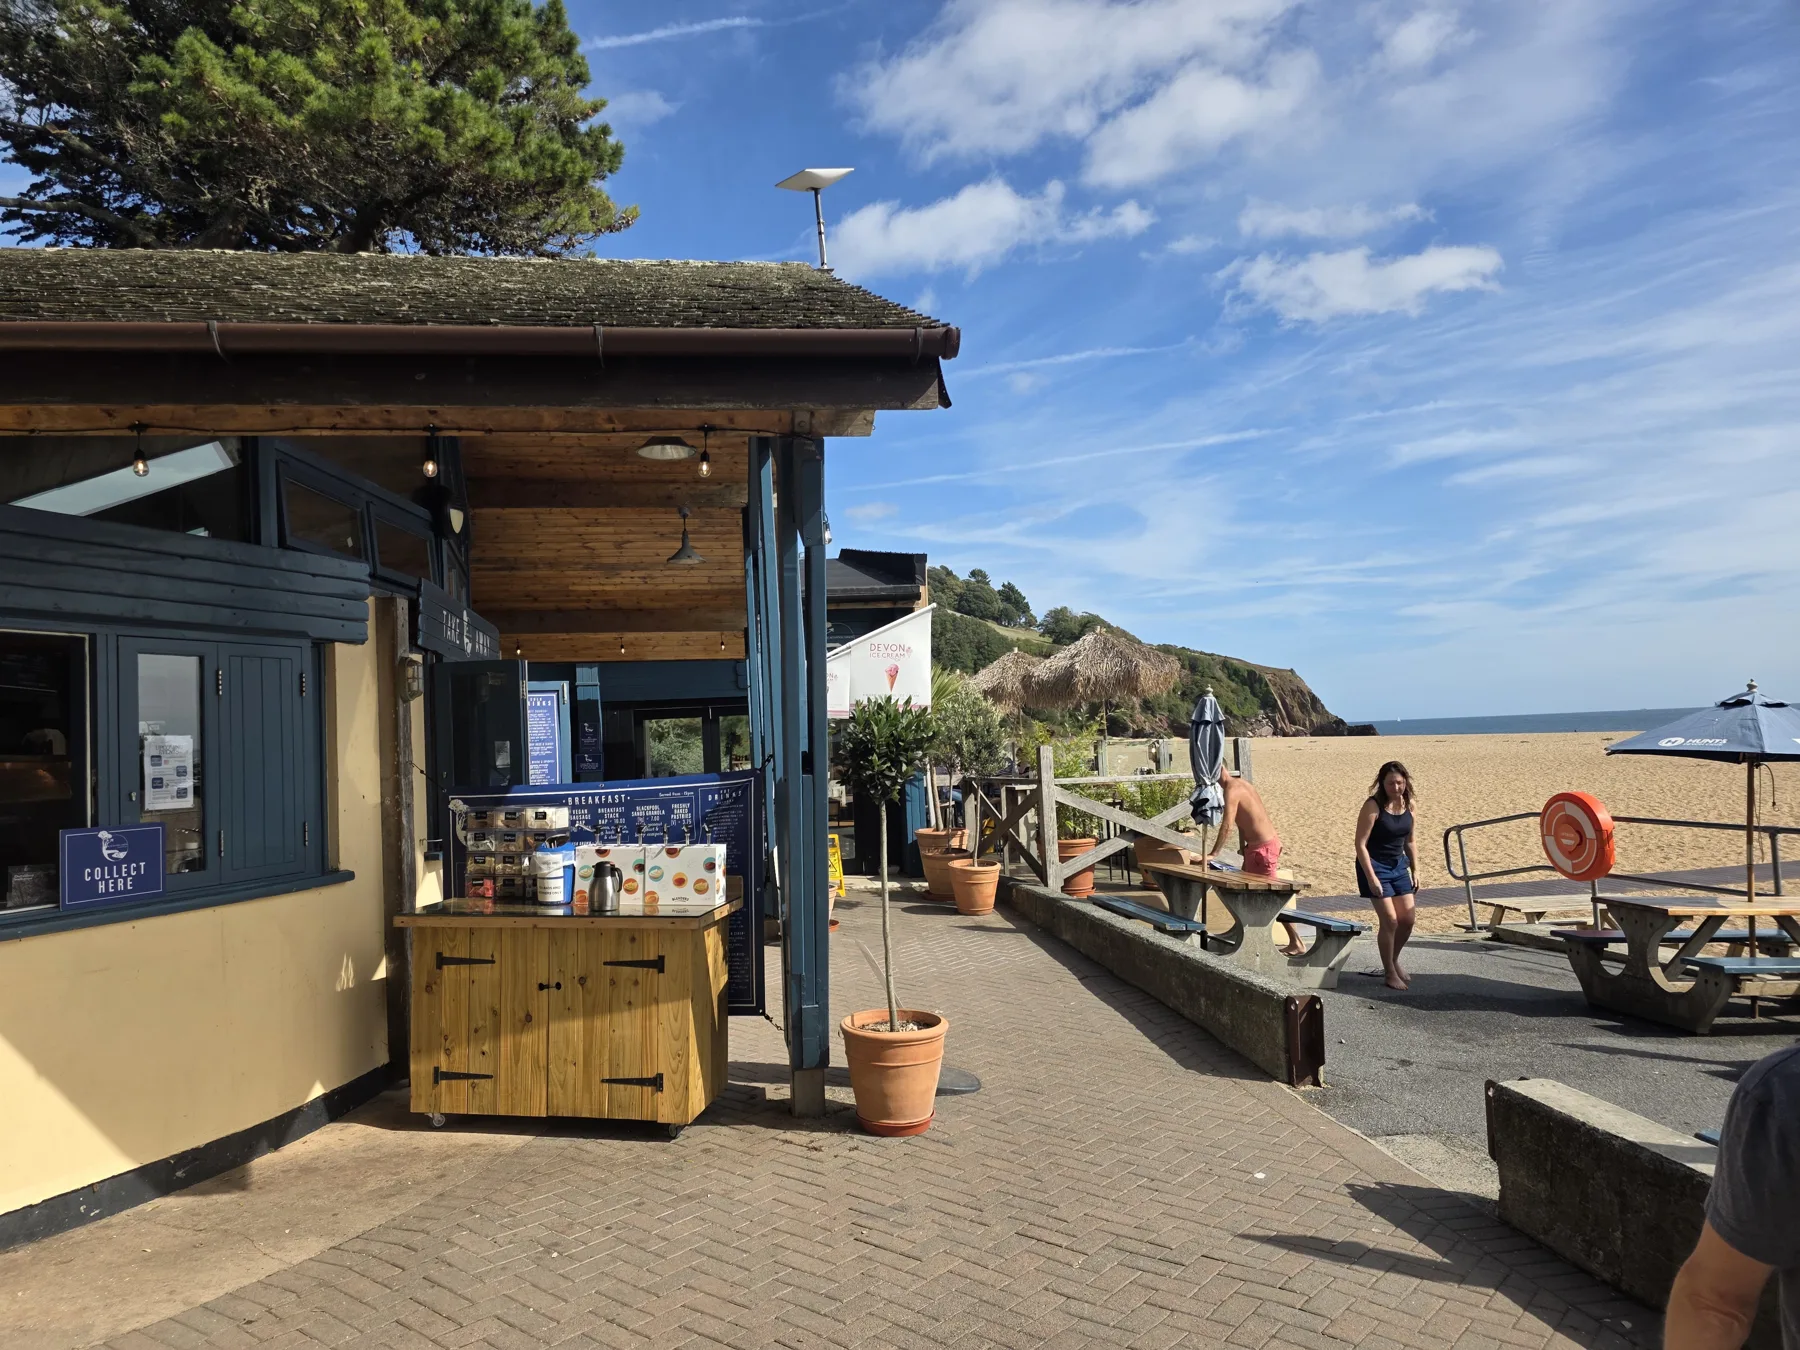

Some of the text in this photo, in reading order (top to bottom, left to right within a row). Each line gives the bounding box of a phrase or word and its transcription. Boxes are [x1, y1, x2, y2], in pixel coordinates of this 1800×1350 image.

[443, 610, 460, 645] TAKE
[475, 630, 490, 658] AWAY
[869, 643, 906, 652] DEVON
[567, 794, 626, 806] BREAKFAST
[708, 790, 742, 802] DRINKS
[598, 806, 625, 814] BREAKFAST
[636, 804, 660, 812] BLACKPOOL
[645, 809, 666, 817] GRANOLA
[84, 861, 146, 882] COLLECT
[98, 877, 134, 894] HERE
